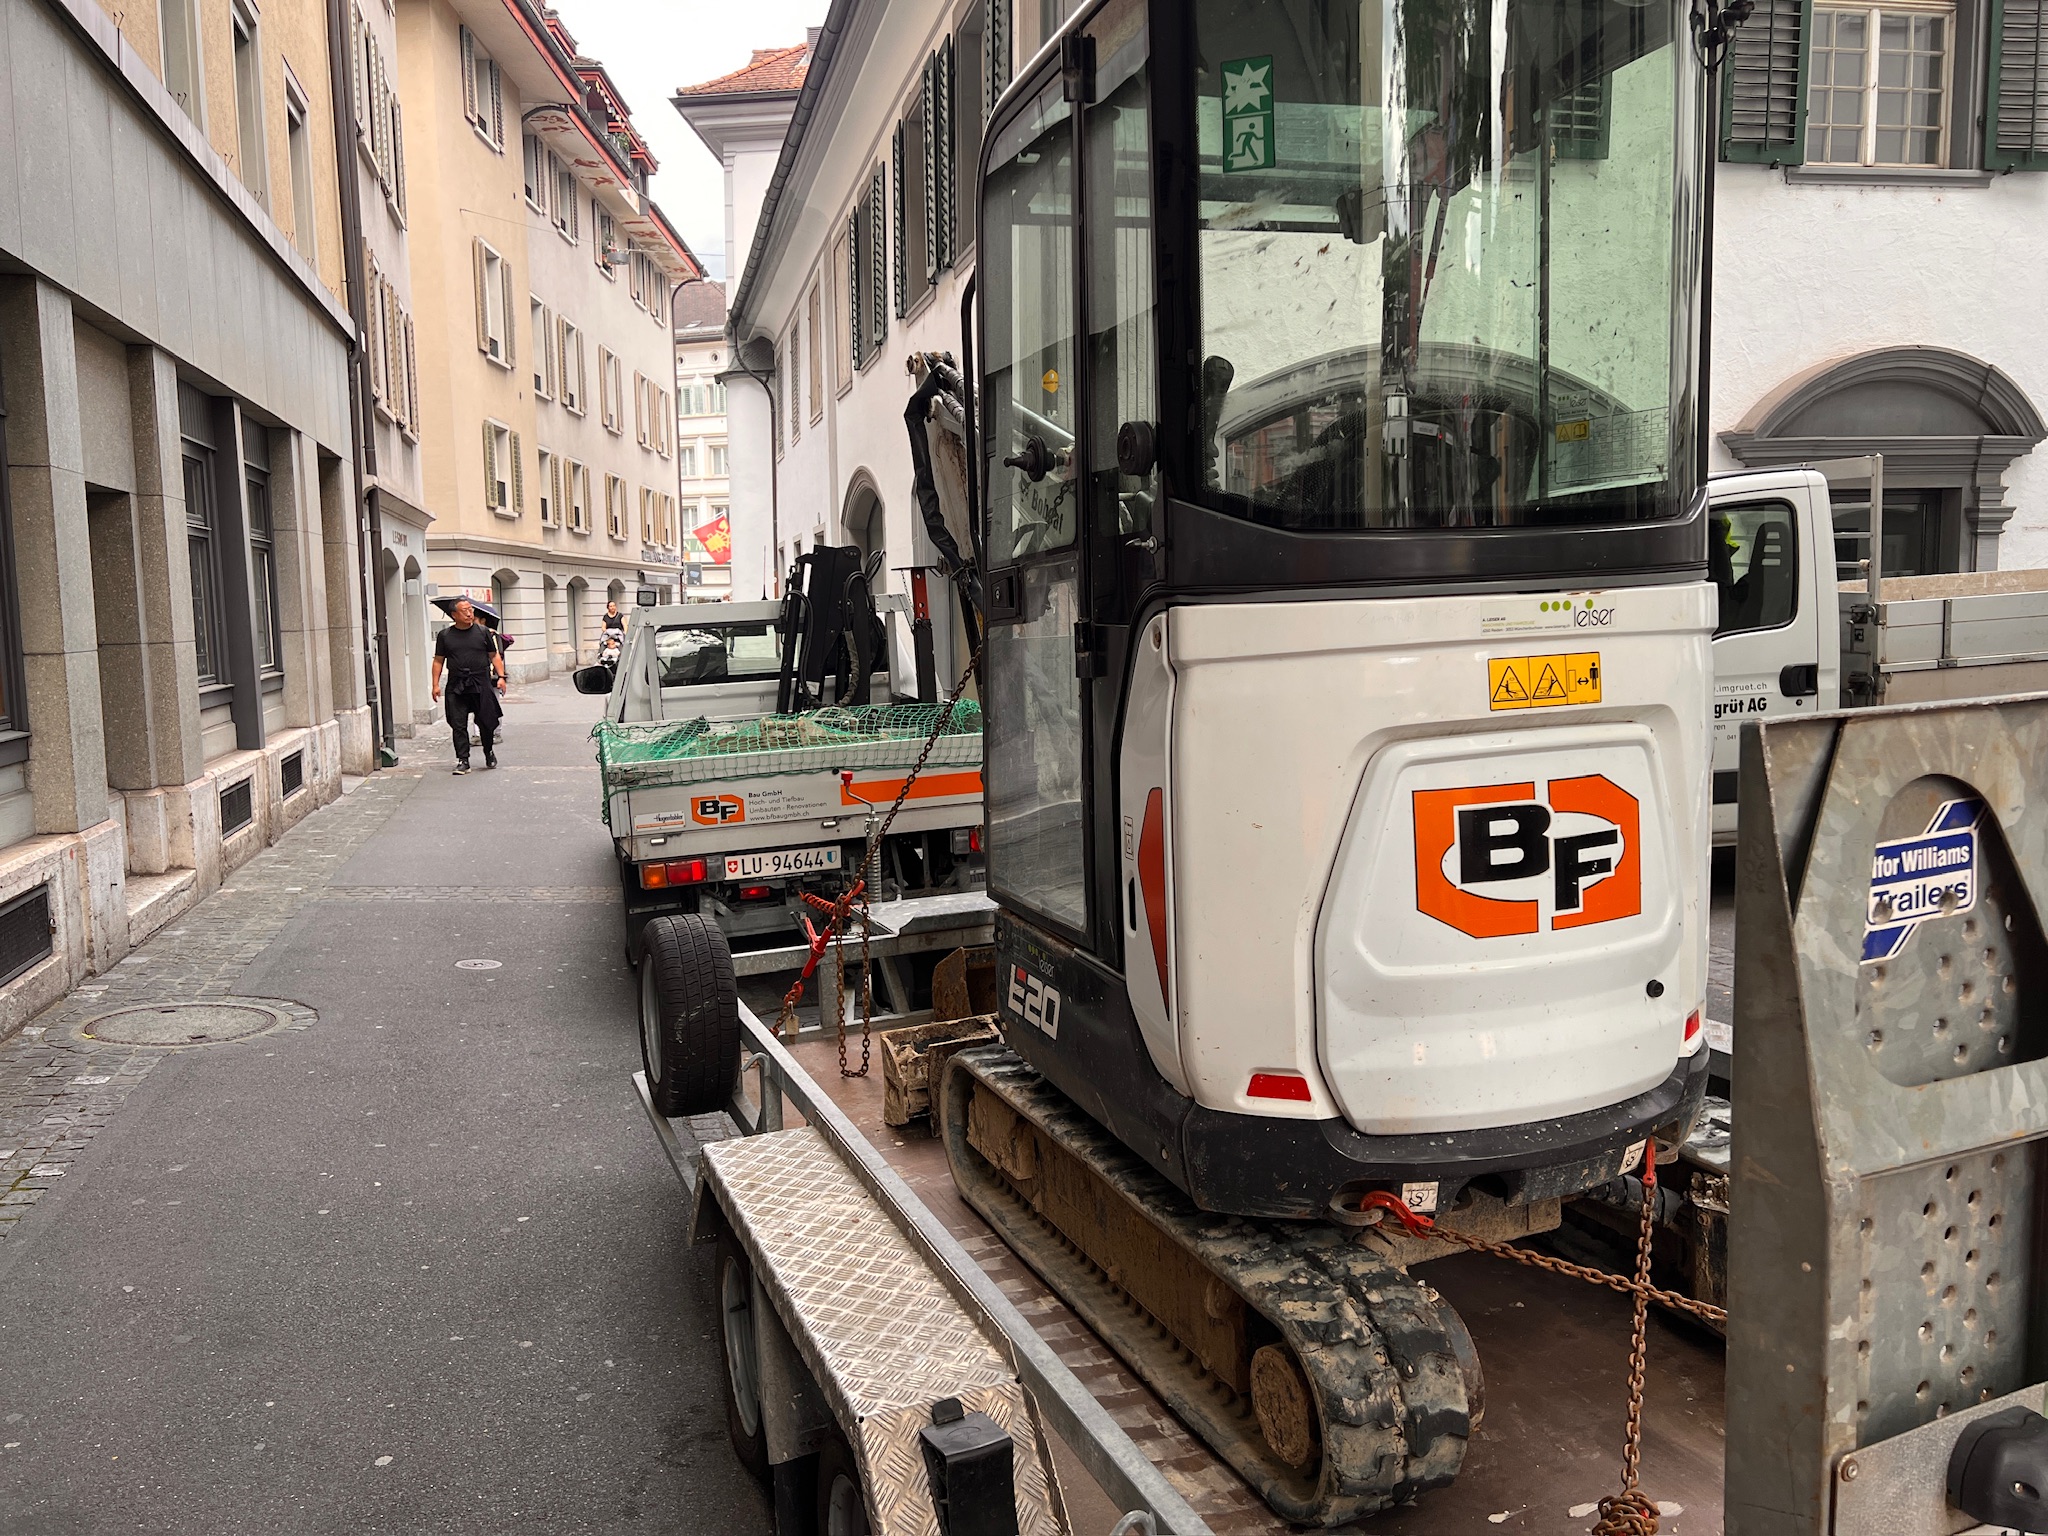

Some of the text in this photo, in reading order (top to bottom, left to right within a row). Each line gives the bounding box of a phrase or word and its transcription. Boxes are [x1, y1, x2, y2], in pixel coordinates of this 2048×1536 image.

[1573, 599, 1615, 628] leiser
[1714, 682, 1767, 693] .imgruet.ch
[1747, 697, 1768, 712] AG
[700, 800, 737, 820] BF
[749, 806, 781, 814] Umbauten
[786, 802, 827, 811] Renovationen
[750, 811, 810, 821] www.bfbaugmbh.ch
[1458, 804, 1618, 911] BF
[1901, 845, 1970, 873] Williams
[1008, 963, 1061, 1040] E20
